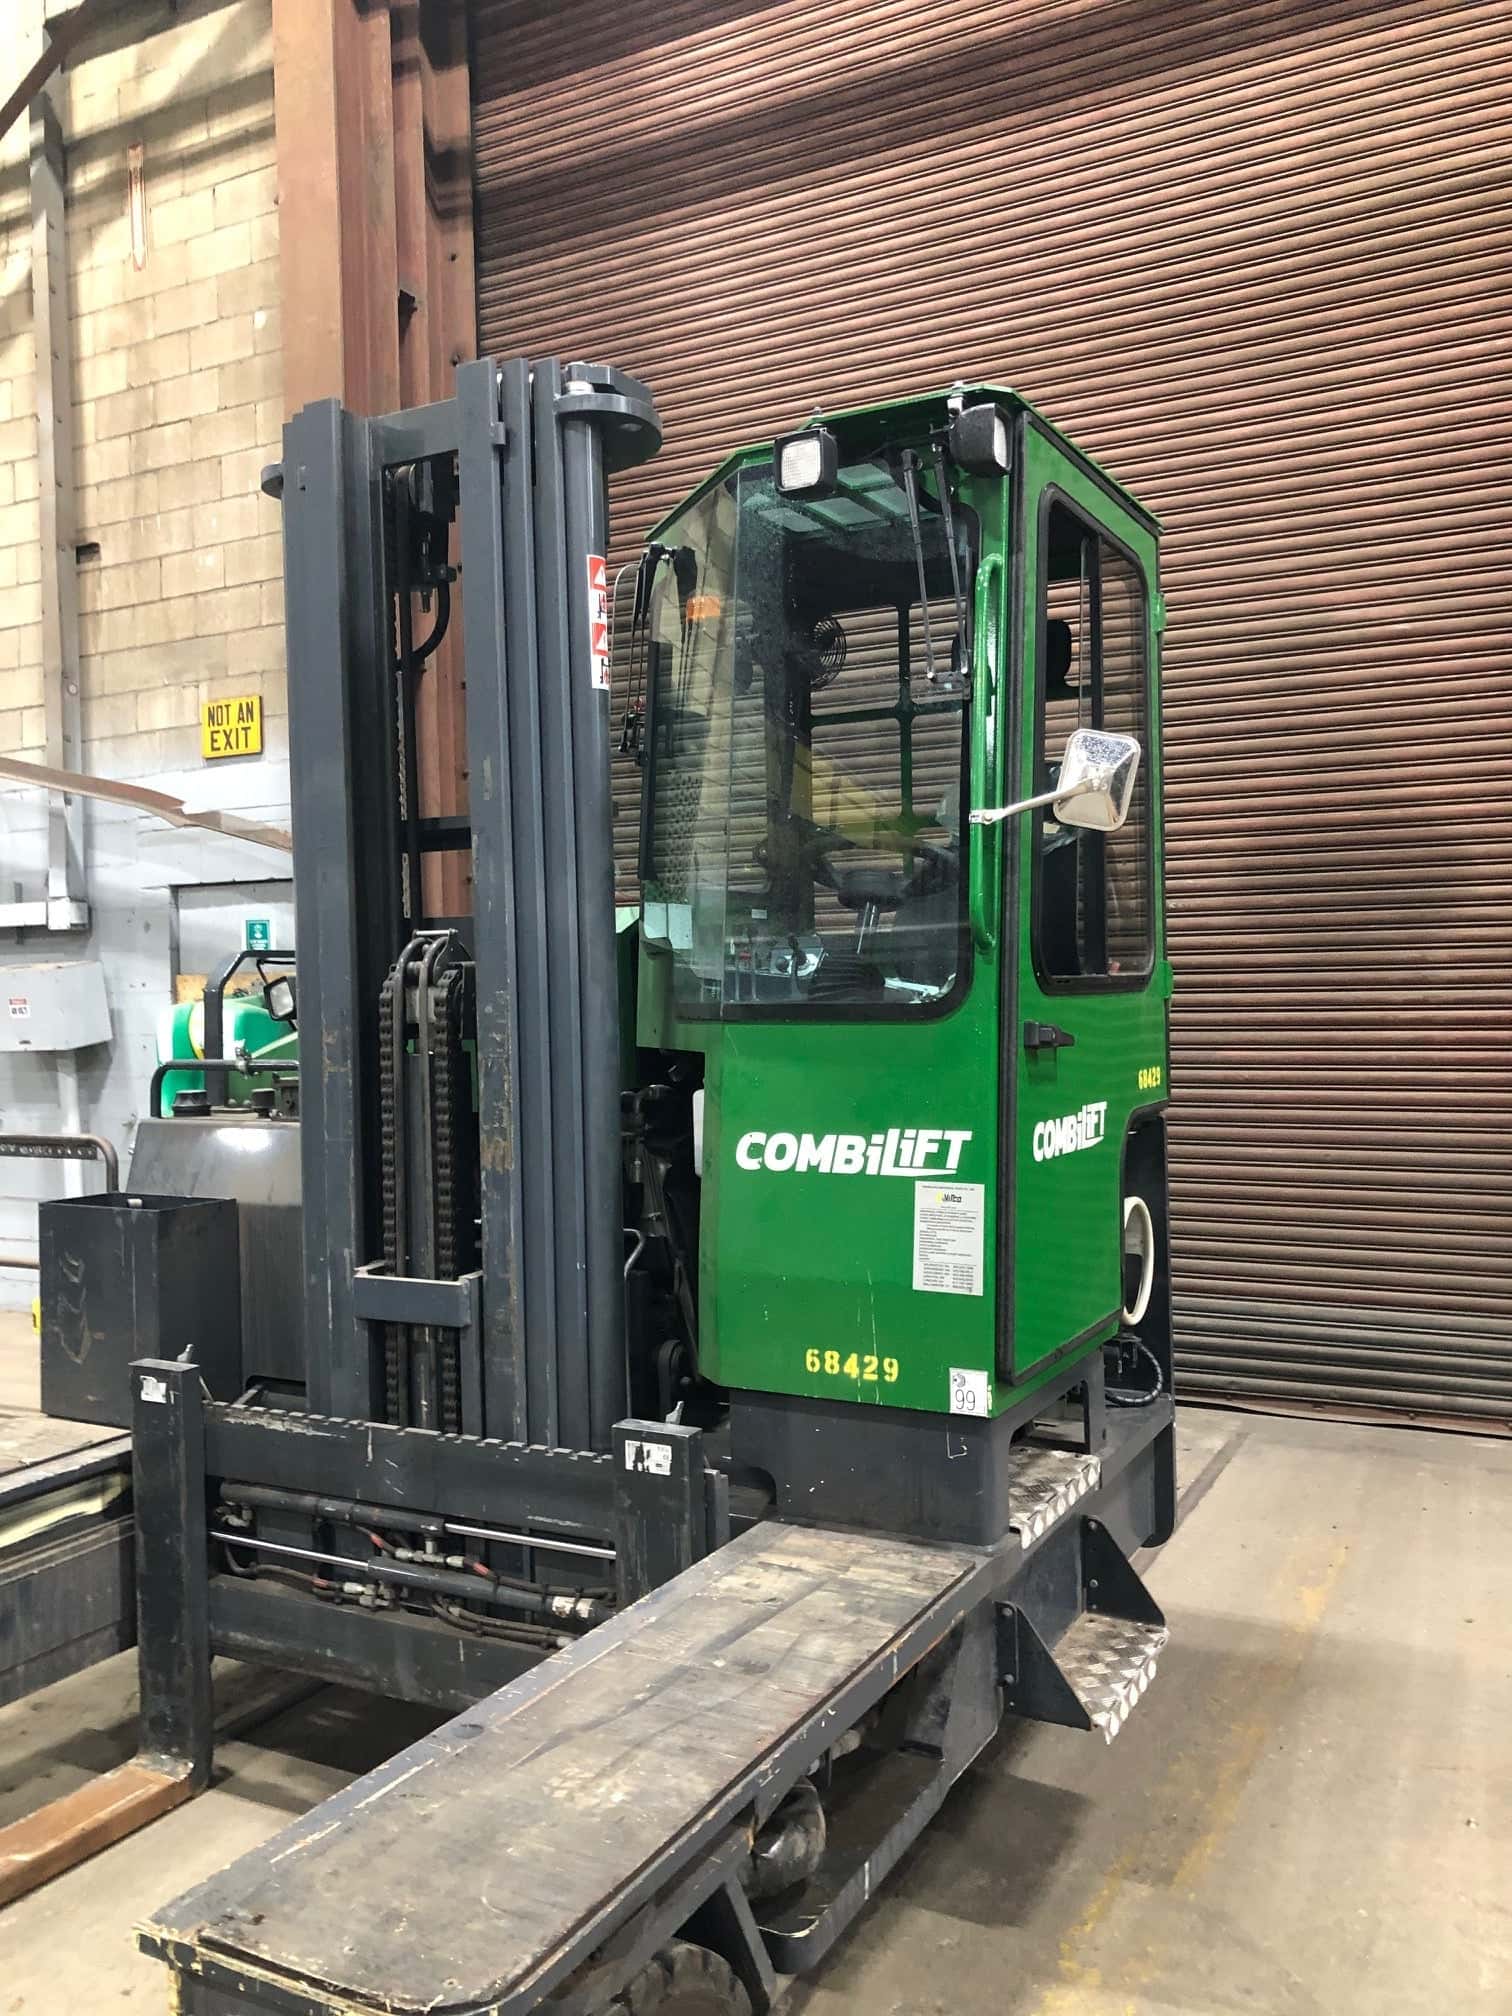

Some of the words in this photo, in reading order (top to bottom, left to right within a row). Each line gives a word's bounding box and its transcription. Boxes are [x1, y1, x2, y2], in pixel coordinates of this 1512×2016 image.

[208, 703, 231, 728] NOT
[237, 700, 254, 725] AN
[210, 726, 252, 752] EXIT
[805, 1348, 899, 1382] 68429
[955, 1388, 976, 1411] 99
